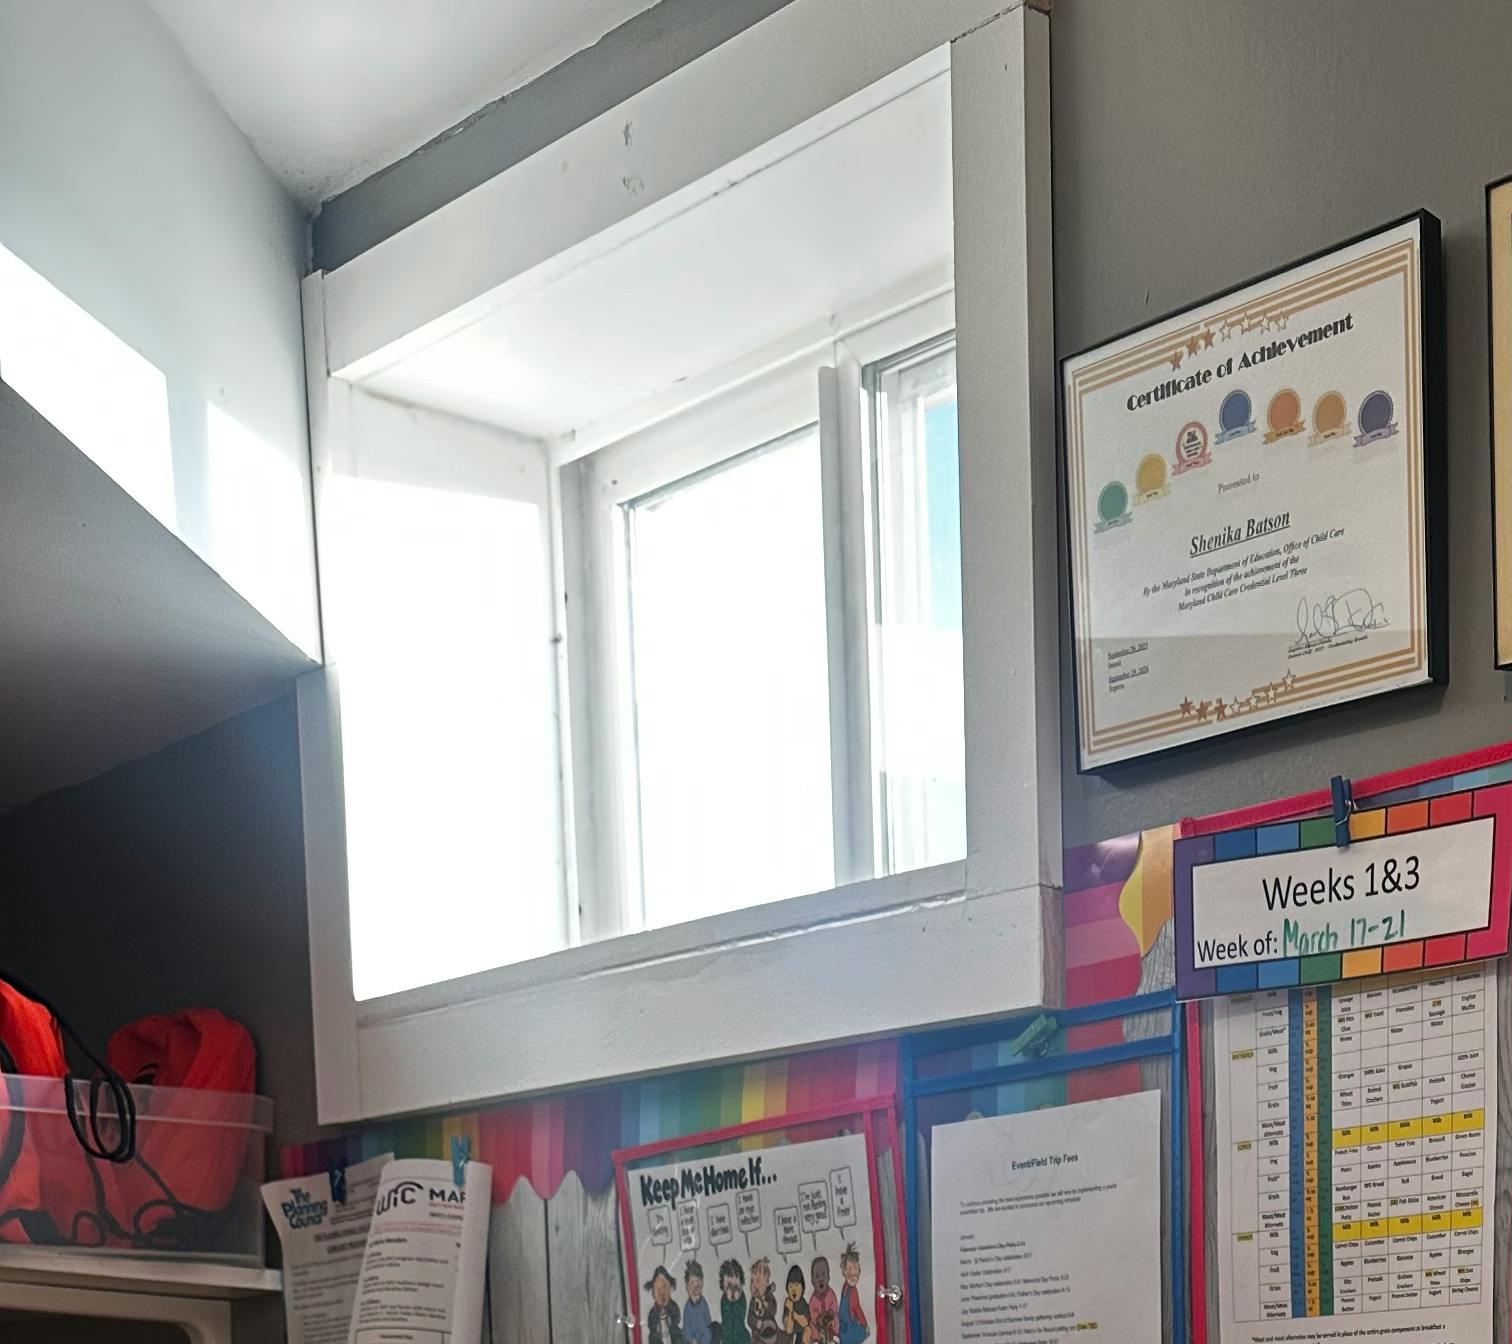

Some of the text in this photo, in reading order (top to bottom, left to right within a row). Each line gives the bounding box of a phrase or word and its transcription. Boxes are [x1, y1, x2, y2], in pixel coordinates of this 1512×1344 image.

[1127, 312, 1354, 411] Certificate of Achievement
[1190, 511, 1290, 556] Shenika Batson
[1311, 531, 1328, 545] Child
[1329, 527, 1345, 538] Care
[1262, 855, 1420, 911] Weeks 1&3
[1197, 909, 1406, 963] Week of: March 17-21
[1048, 1154, 1062, 1166] Trip
[1063, 1153, 1079, 1163] Fees
[639, 1174, 680, 1211] Keep
[681, 1167, 704, 1199] Me
[702, 1165, 749, 1196] Home
